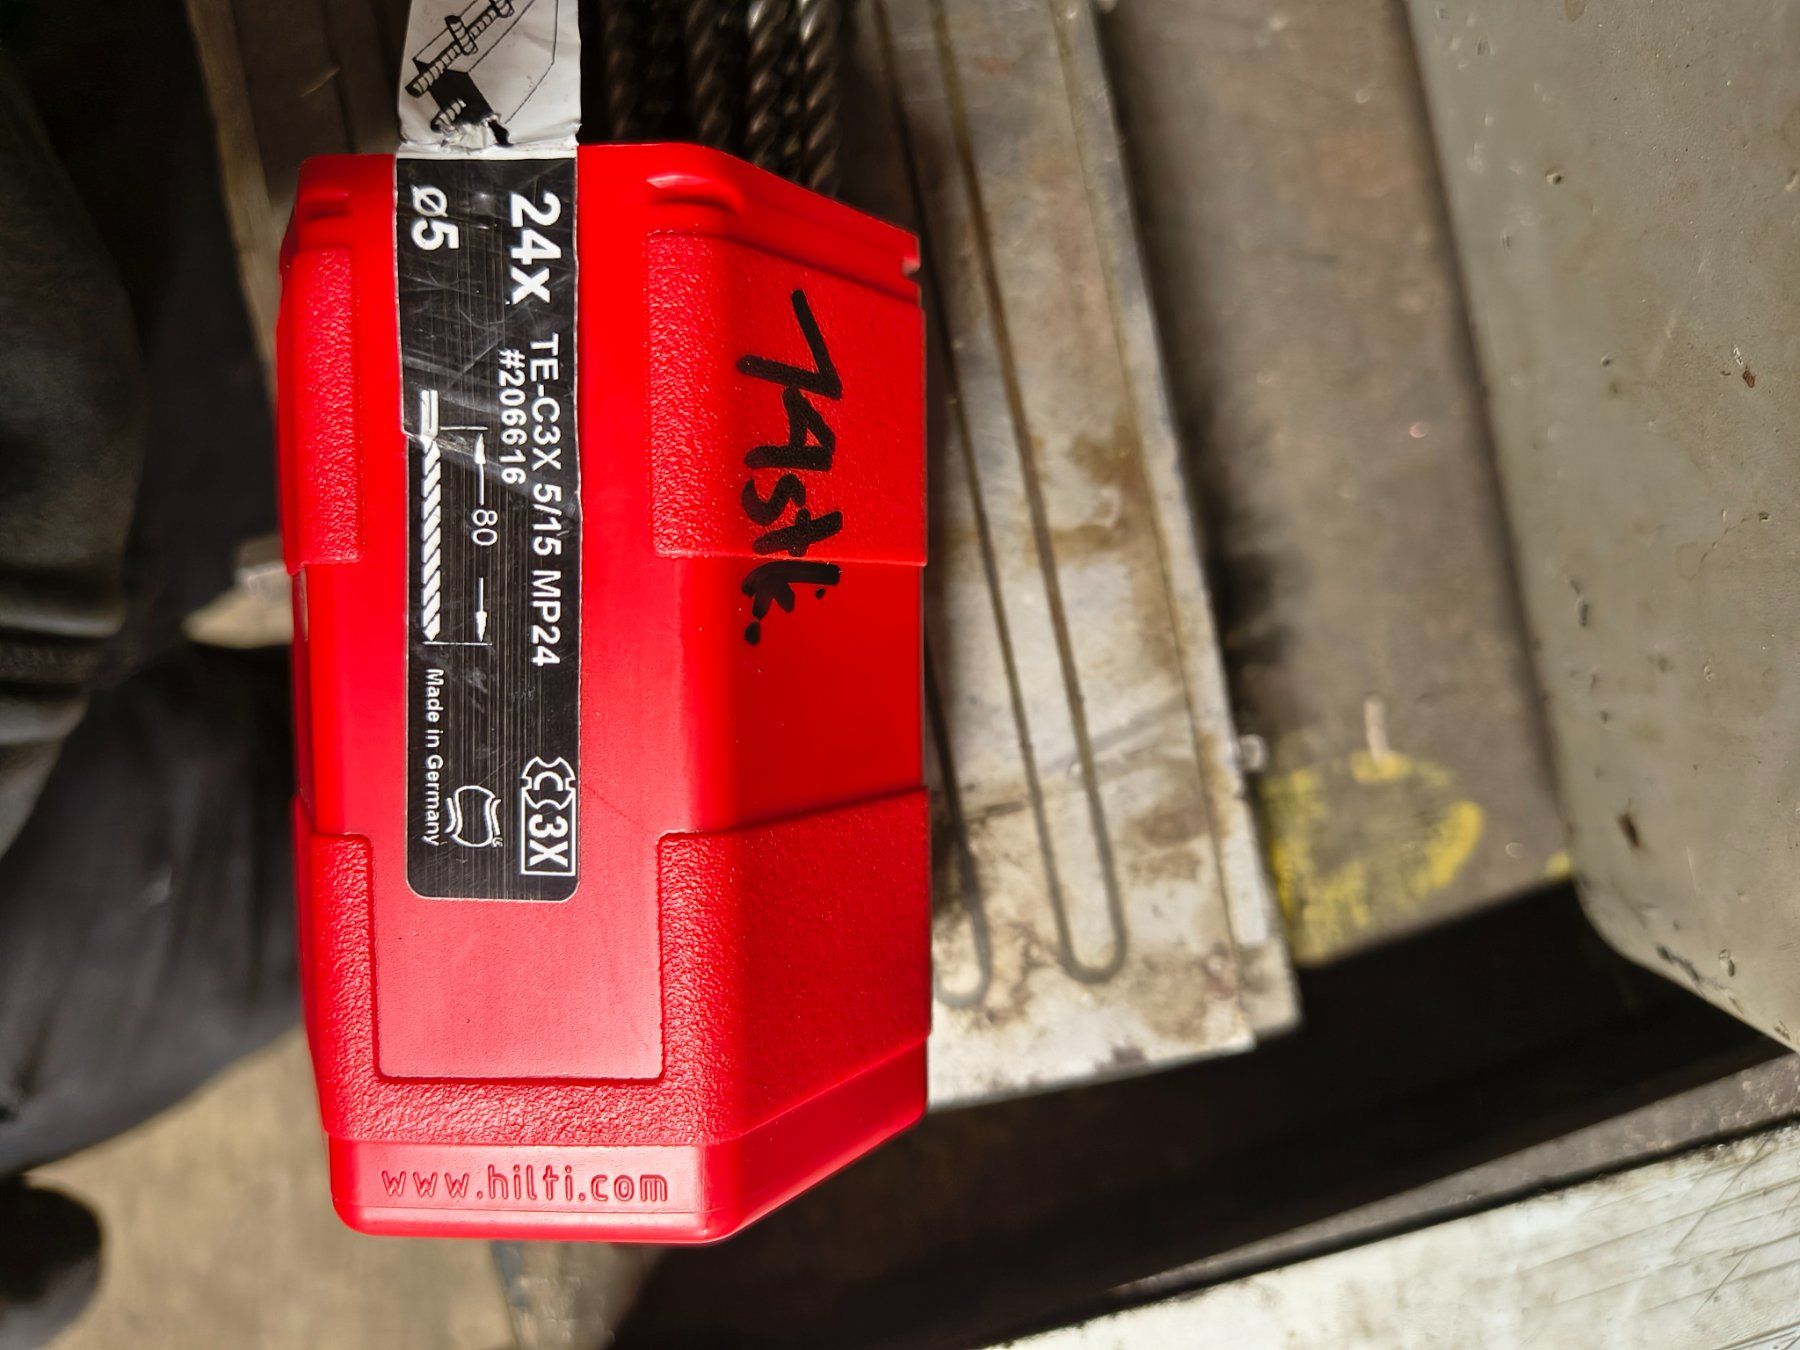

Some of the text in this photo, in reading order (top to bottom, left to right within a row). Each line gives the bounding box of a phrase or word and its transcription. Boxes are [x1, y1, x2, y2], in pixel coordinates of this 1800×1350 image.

[510, 191, 562, 304] 24x
[498, 350, 528, 485] #206616
[472, 509, 499, 546] 80
[530, 332, 562, 667] TE-C3X 5/15 MP24
[421, 668, 445, 847] Made in Germany
[381, 1164, 669, 1202] www.hilti.com
